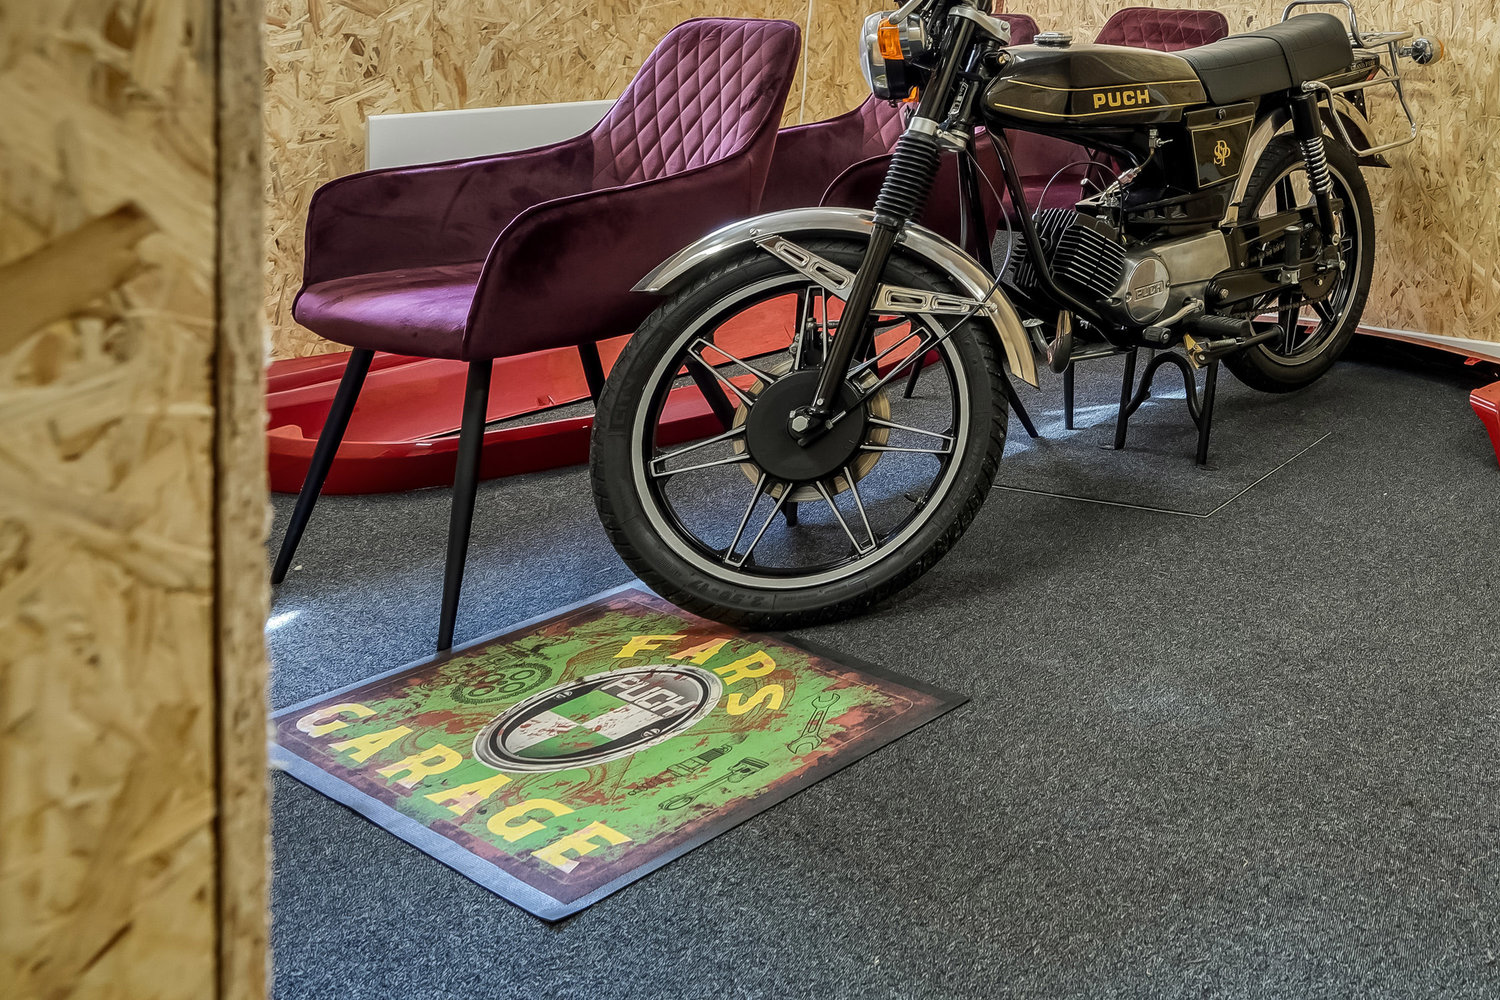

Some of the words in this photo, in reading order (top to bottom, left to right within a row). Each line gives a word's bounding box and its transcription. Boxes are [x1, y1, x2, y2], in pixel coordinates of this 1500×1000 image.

[1093, 89, 1150, 109] PUCH
[601, 676, 697, 718] PUCH
[614, 634, 782, 719] FARS
[295, 702, 633, 874] GARAGE
